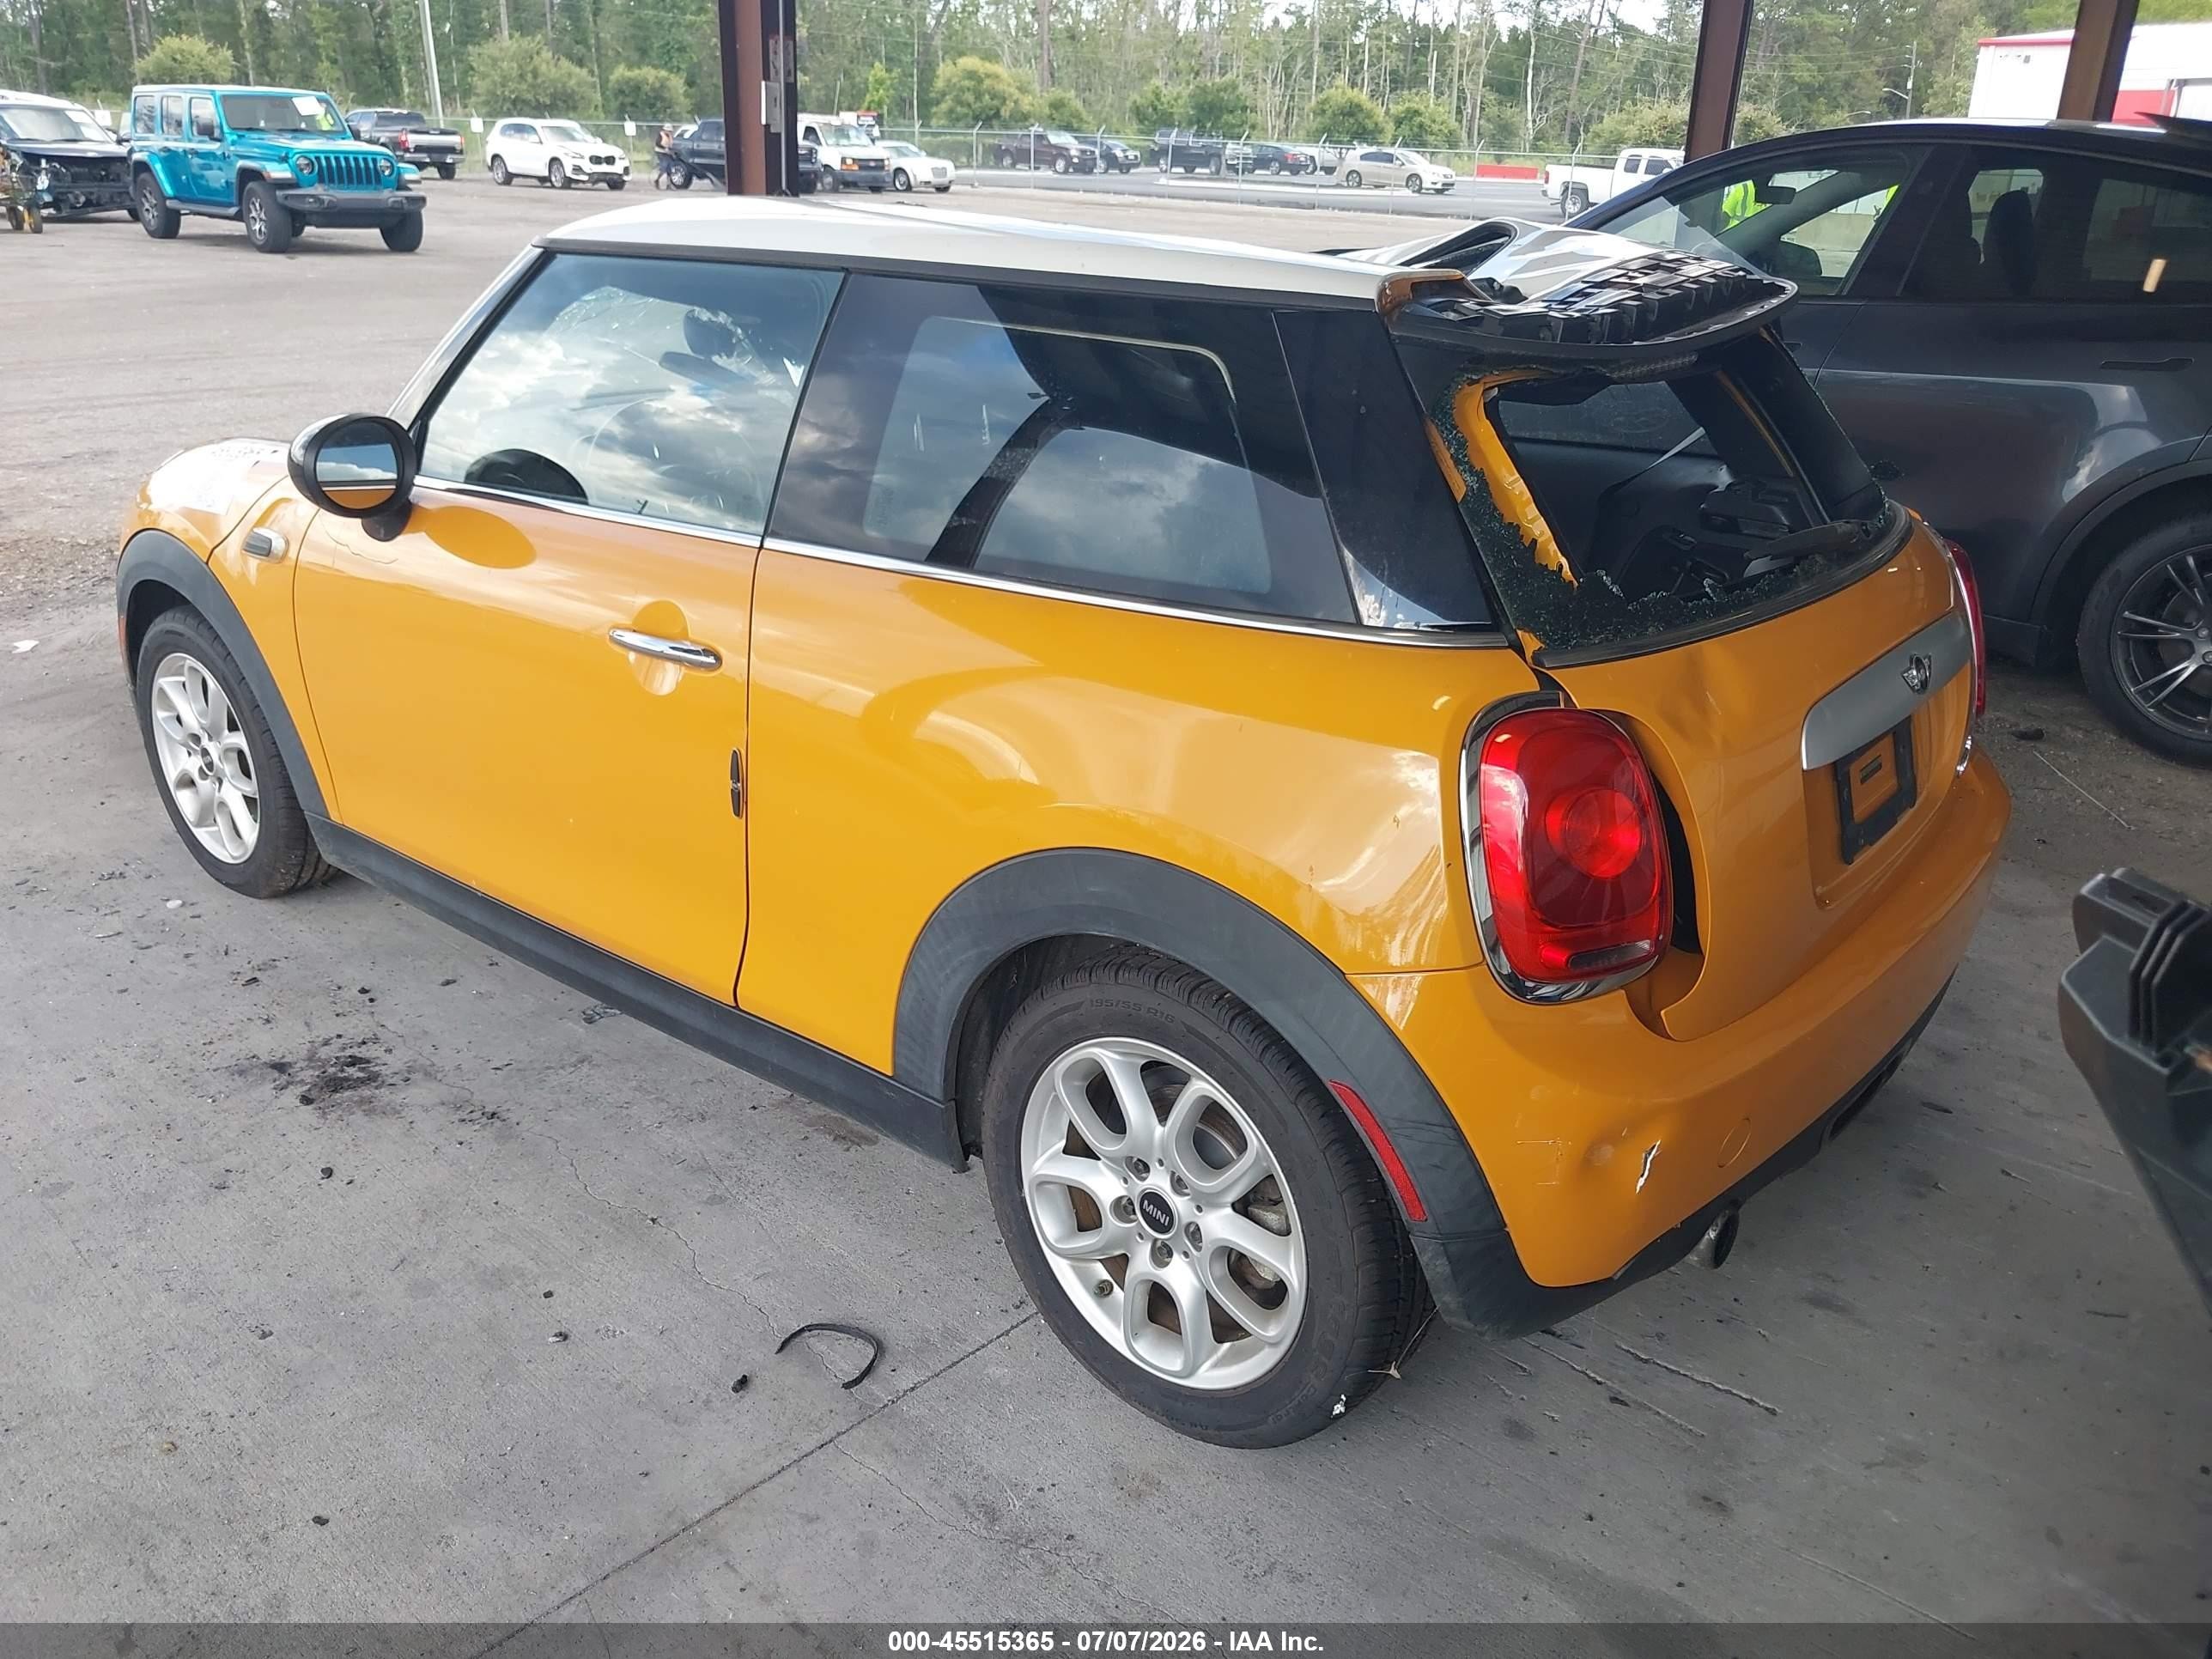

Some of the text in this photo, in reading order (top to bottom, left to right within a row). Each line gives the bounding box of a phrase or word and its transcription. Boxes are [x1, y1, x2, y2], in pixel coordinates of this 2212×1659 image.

[1089, 998, 1176, 1024] 195/55 R16
[1142, 1199, 1170, 1226] MINI
